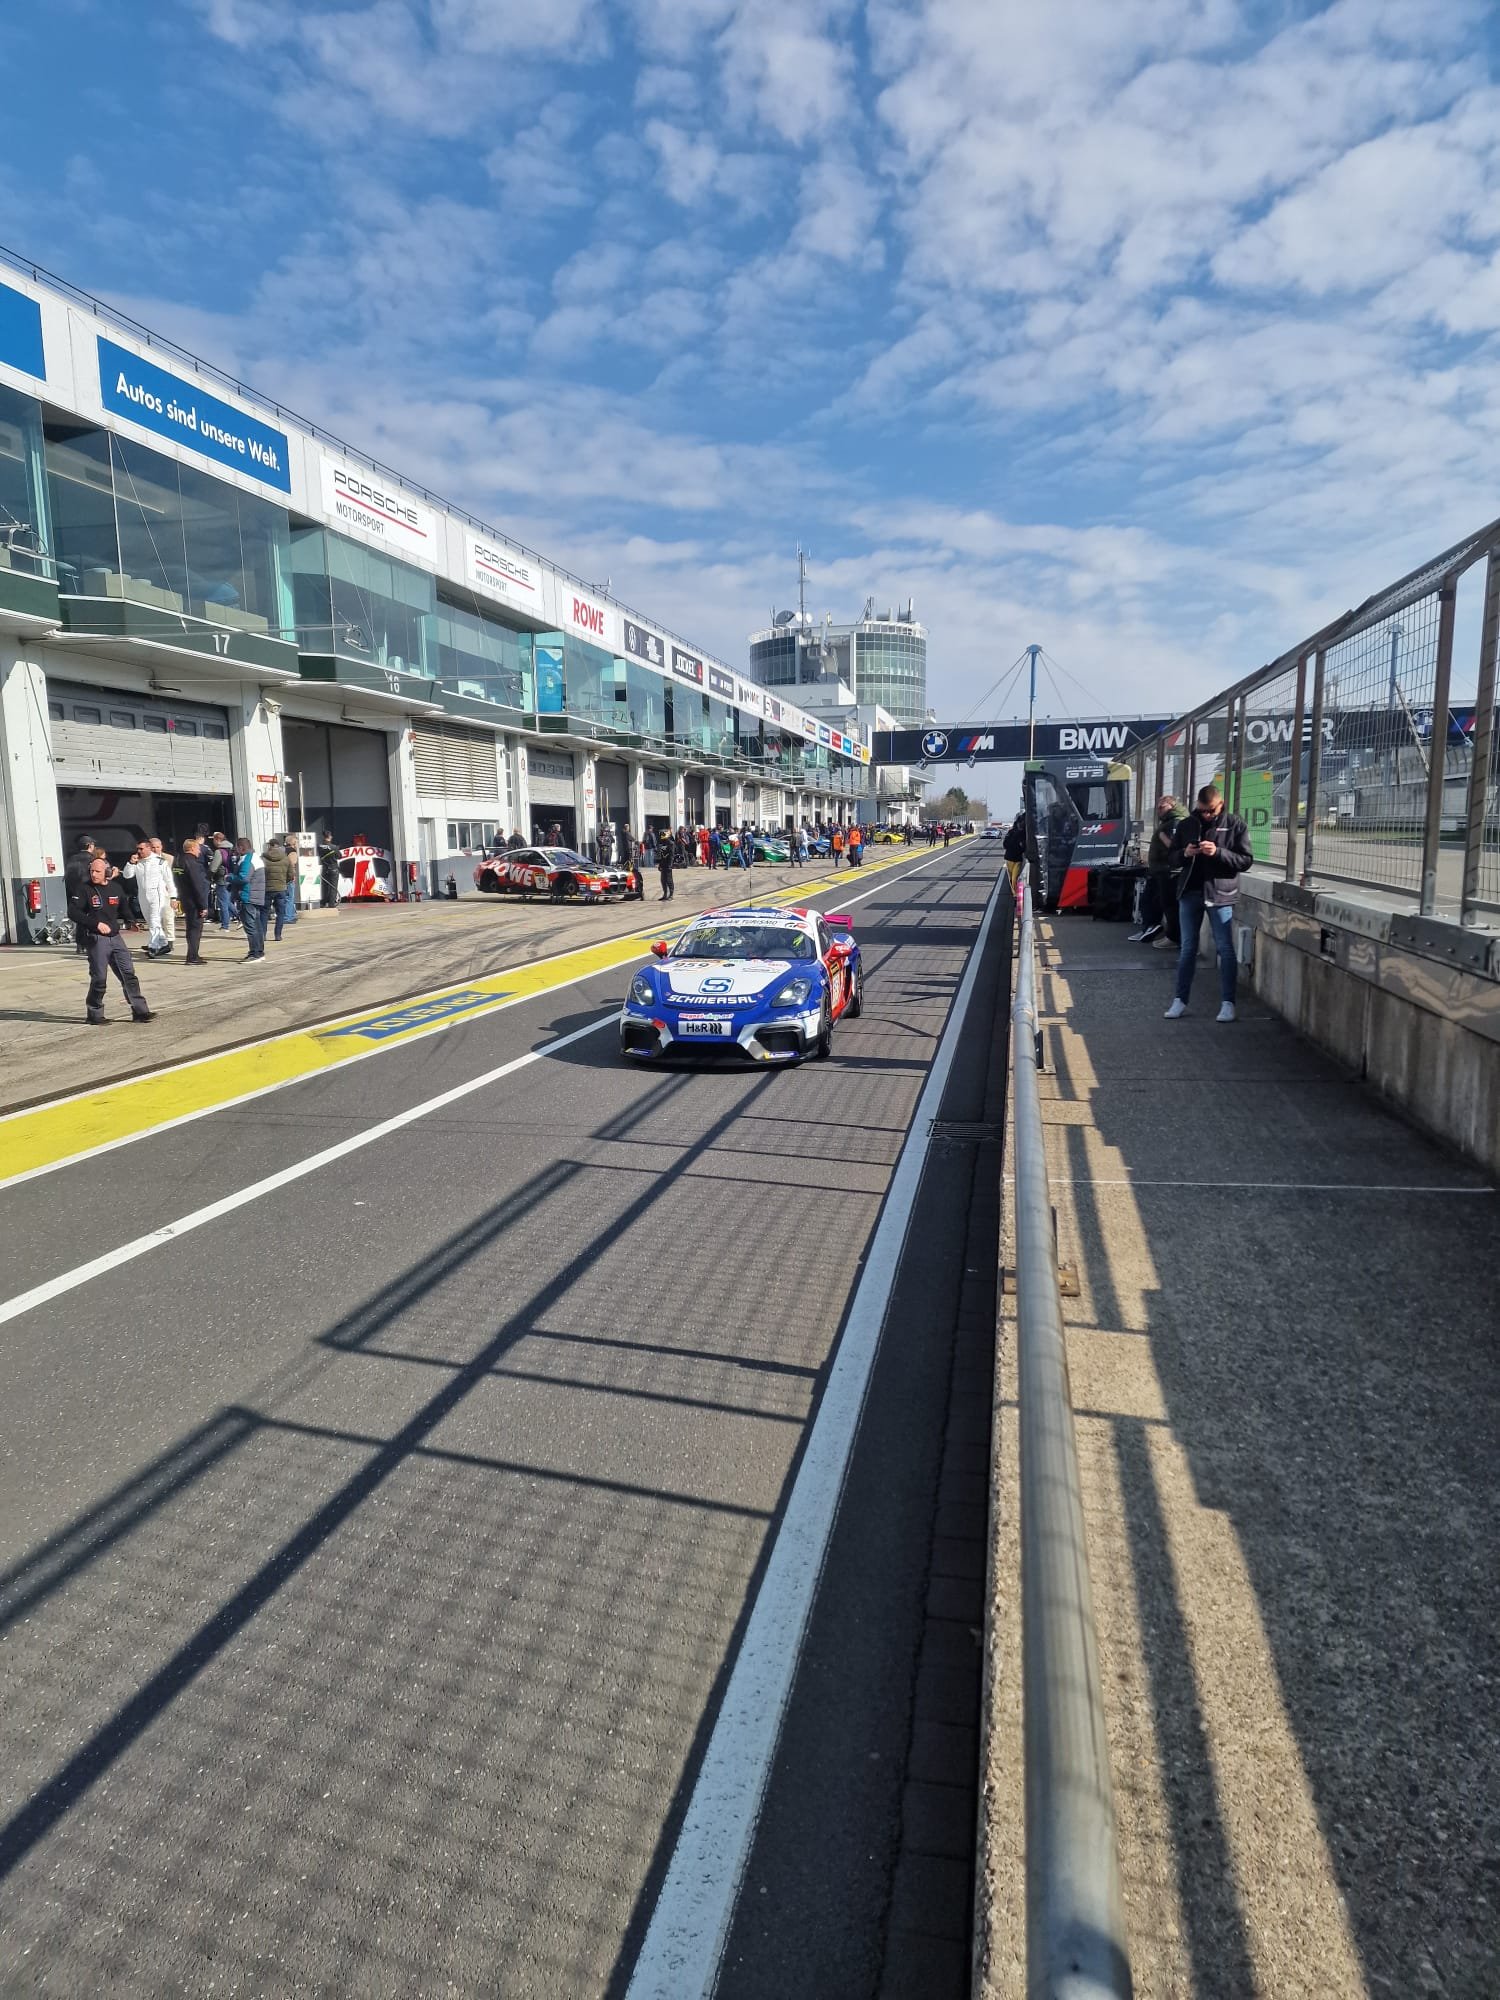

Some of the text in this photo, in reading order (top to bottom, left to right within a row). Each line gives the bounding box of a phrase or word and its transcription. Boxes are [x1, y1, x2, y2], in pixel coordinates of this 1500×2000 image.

[116, 372, 281, 471] Autos sind unsere Welt.
[334, 469, 418, 526] PORSCHE
[336, 502, 385, 535] MOTORSPORT
[474, 544, 529, 582] PORSCHE
[475, 568, 508, 592] MOTORSPORT
[573, 597, 604, 636] ROWE
[212, 634, 230, 655] 17
[388, 674, 400, 693] 16
[1059, 727, 1129, 751] BMW
[1066, 769, 1104, 778] GT3
[342, 847, 386, 858] ROWE
[486, 859, 534, 887] ROWE
[667, 993, 757, 1005] SCHMERSAL
[686, 1022, 709, 1034] H&R
